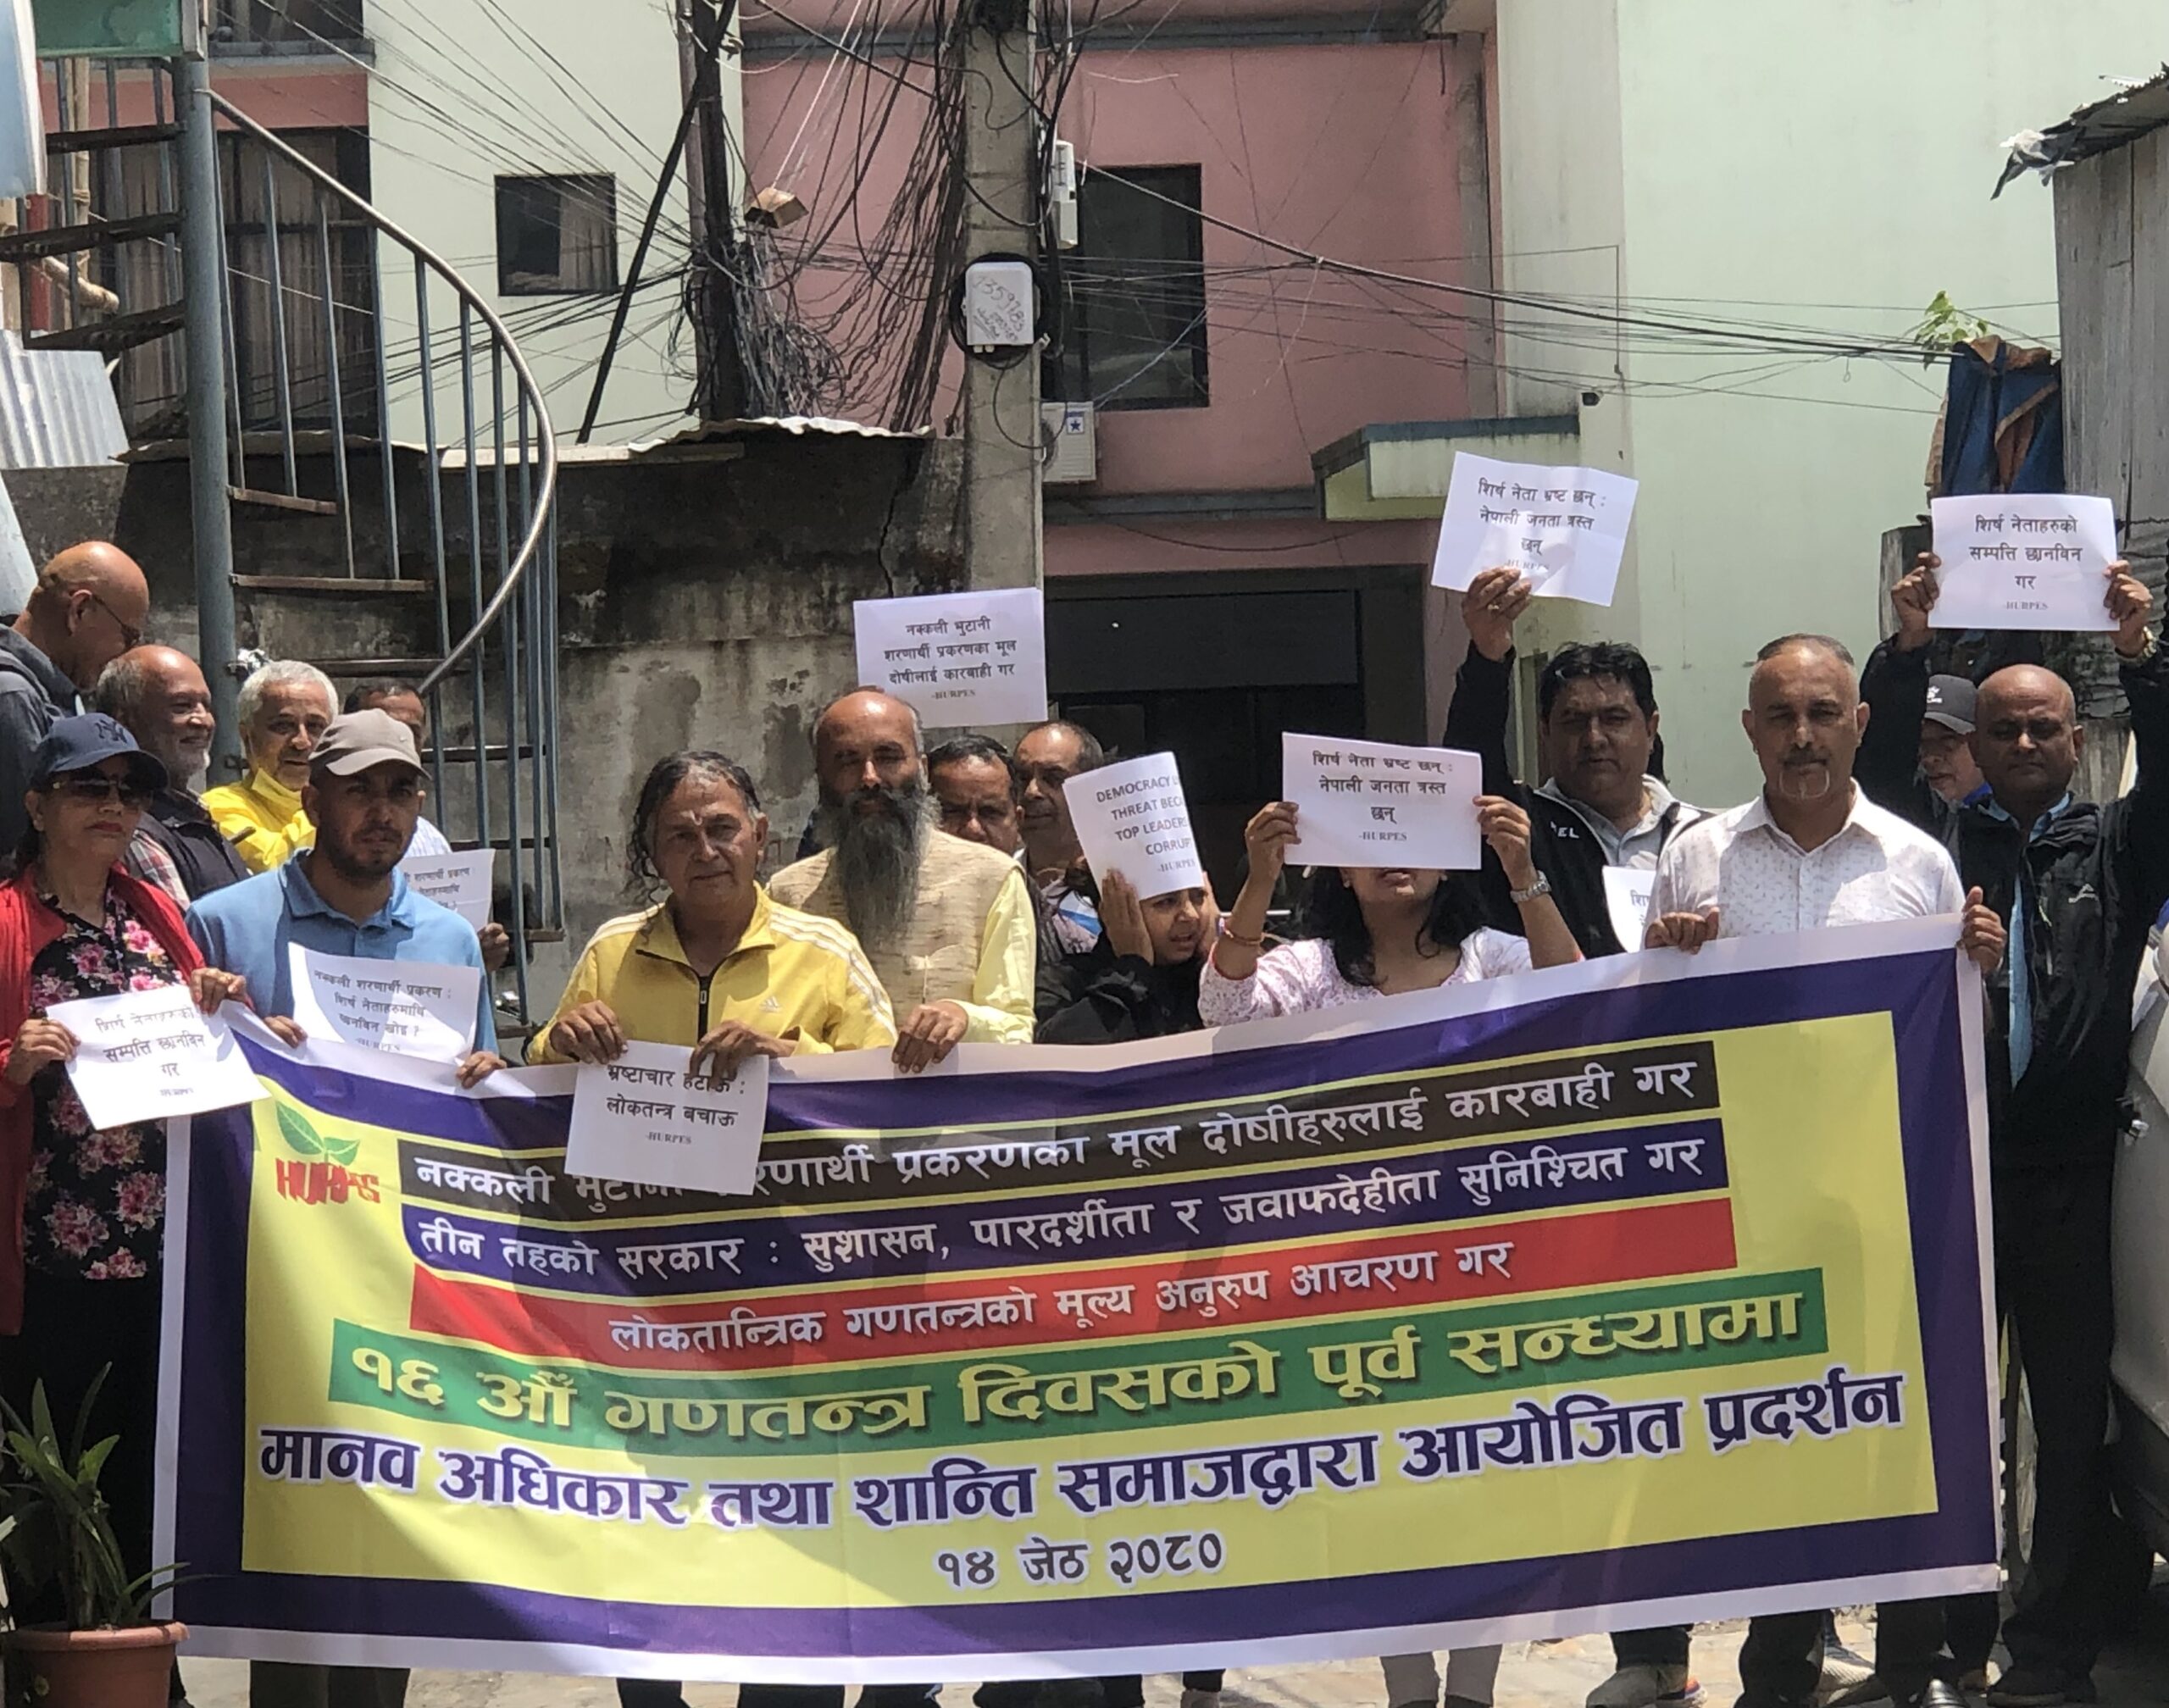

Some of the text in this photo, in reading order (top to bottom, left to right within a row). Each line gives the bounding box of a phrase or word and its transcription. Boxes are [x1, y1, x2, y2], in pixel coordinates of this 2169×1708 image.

[1478, 477, 1506, 497] शिर्ष
[1512, 483, 1538, 502] नेता
[1573, 490, 1595, 508] छन्
[1480, 506, 1520, 525] नेपाली
[1527, 513, 1562, 528] जनता
[1975, 513, 2077, 534] शिर्ष नेताहरुको
[1969, 542, 2018, 561] सम्पत्ति
[2015, 574, 2036, 590] गर
[905, 615, 990, 636] नक्कली भुटानी
[885, 640, 1017, 662] शरणार्थी प्रकरणका मूल
[890, 666, 938, 685] दोषीलाई
[998, 663, 1015, 676] गर
[1312, 750, 1340, 766] शिर्ष
[1349, 752, 1375, 767] नेता
[1417, 761, 1444, 774] छन्
[1096, 777, 1170, 802] DEMOCRACY
[1319, 774, 1446, 795] नेपाली जनता त्रस्त
[1112, 800, 1157, 820] THREAT
[1371, 807, 1397, 824] छन्
[1115, 826, 1140, 841] TOP
[407, 984, 442, 999] प्रकरण
[103, 1038, 152, 1062] सम्पत्ति
[161, 1062, 180, 1077] गर
[607, 1064, 675, 1087] भ्रष्टाचार
[607, 1094, 738, 1127] लोकतन्त्र बचाऊ
[415, 1157, 555, 1204] नक्कली
[753, 1144, 874, 1195] रणार्थी
[892, 1136, 1090, 1184] प्रकरणका
[1107, 1125, 1182, 1167] मूल
[1200, 1087, 1428, 1154] दोषीहरुलाई
[1446, 1062, 1614, 1121] कारबाही
[1633, 1061, 1698, 1098] गर
[419, 1217, 485, 1261] तीन
[500, 1239, 600, 1276] तहको
[616, 1238, 745, 1280] सरकार
[801, 1223, 950, 1273] सुशासन,
[969, 1198, 1155, 1251] पारदर्शीता
[1171, 1198, 1203, 1234] र
[1219, 1166, 1441, 1225] जवाफदेहीता
[1456, 1145, 1628, 1206] सुनिश्चित
[1645, 1139, 1706, 1176] गर
[607, 1242, 1515, 1353] लोकतान्त्रिक गणतन्त्रको मूल्य अनुरुप आचरण गर
[352, 1346, 445, 1406] १६
[604, 1384, 931, 1438] गणतन्त्र
[959, 1340, 1280, 1422] दिवसको
[1308, 1325, 1421, 1399] पूर्व
[1448, 1291, 1803, 1373] सन्ध्यामा
[261, 1368, 1904, 1528] मानव अधिकार तथा शान्ति समाजद्वारा आयोजित प्रदर्शन
[937, 1533, 1222, 1587] १४ जेठ २०८०
